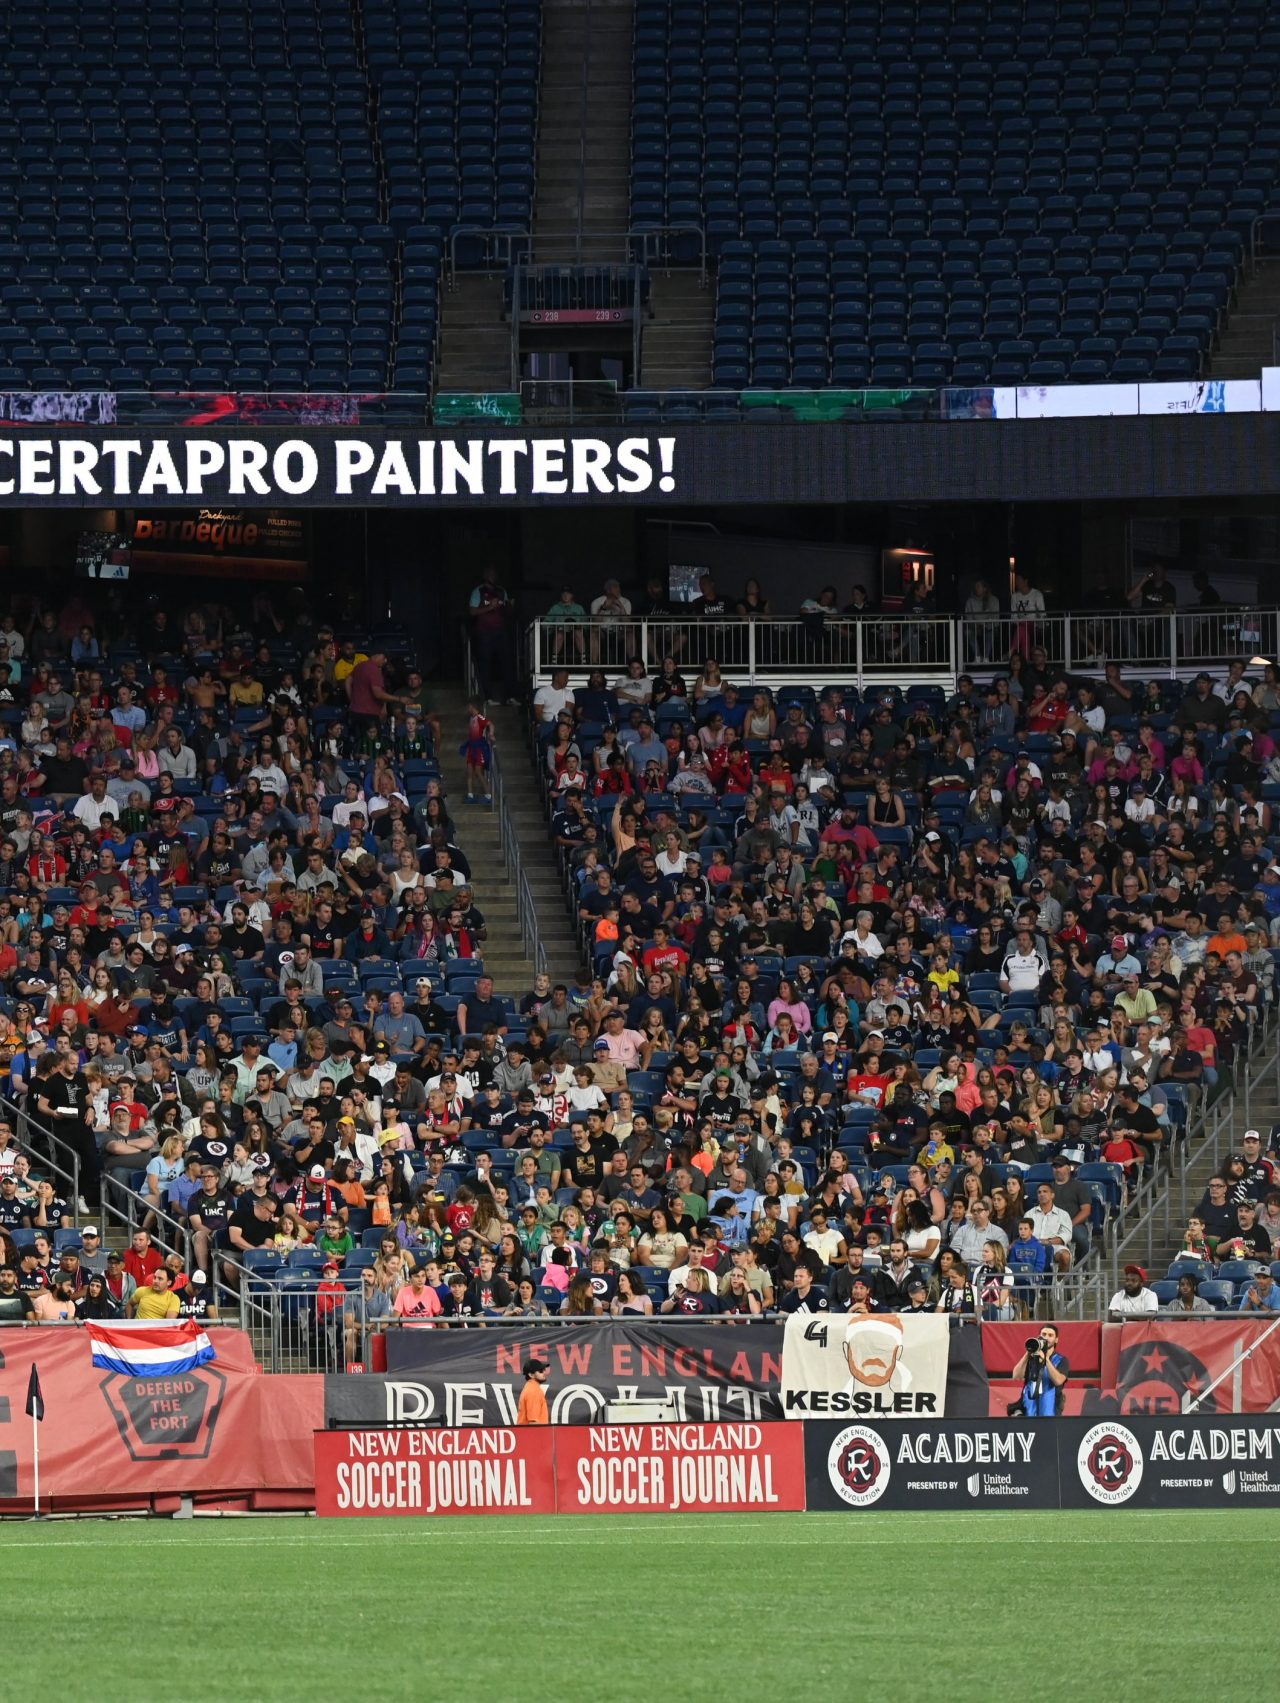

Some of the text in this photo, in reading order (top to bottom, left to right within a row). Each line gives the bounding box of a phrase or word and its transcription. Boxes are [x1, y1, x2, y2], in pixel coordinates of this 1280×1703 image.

[544, 310, 610, 321] 238 239
[334, 437, 677, 495] PAINTERS!
[205, 1207, 224, 1217] UHC
[185, 1304, 205, 1314] UHC
[804, 1321, 828, 1347] 4
[496, 1343, 782, 1384] NEW ENGLAN
[135, 1381, 195, 1396] DEFEND
[151, 1399, 181, 1413] THE
[786, 1390, 937, 1413] KESSLER
[150, 1416, 188, 1430] FORT
[349, 1430, 516, 1457] NEW ENGLAND
[590, 1425, 761, 1452] NEW ENGLAND
[850, 1429, 882, 1448] ENGLAND
[1101, 1426, 1134, 1445] ENGLAND
[897, 1432, 1036, 1463] ACADEMY
[578, 1455, 778, 1509] SOCCER JOURNAL
[983, 1473, 1012, 1484] United
[1160, 1479, 1214, 1488] PRESENTED BY
[1240, 1470, 1268, 1481] United
[337, 1459, 531, 1512] SOCCER JOURNAL
[907, 1481, 958, 1490] PRESENTED BY
[984, 1484, 1029, 1495] Healthcare
[1090, 1484, 1133, 1501] REVOLUTION
[1240, 1481, 1280, 1492] Healthcar
[840, 1486, 881, 1503] REVOLUTION
